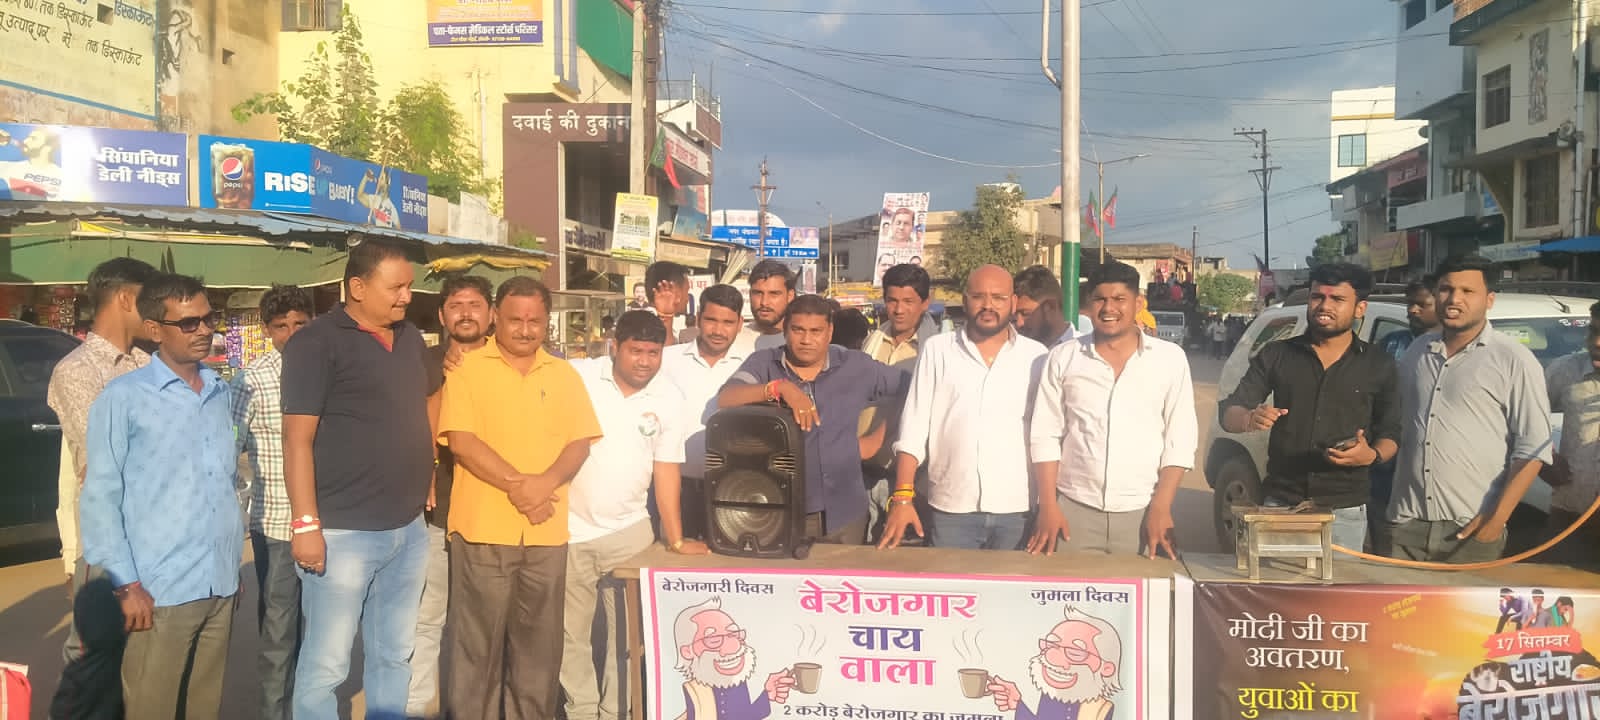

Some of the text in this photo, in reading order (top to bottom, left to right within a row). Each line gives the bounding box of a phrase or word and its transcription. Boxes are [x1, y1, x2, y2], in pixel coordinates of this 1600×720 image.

[512, 109, 631, 136] दवाई की दुकान
[98, 147, 179, 168] सिंघानिया
[98, 164, 132, 182] डेली
[662, 577, 774, 595] बेरोजगारी दिवस
[798, 579, 977, 618] बेरोजगार
[1031, 586, 1129, 605] जुमला दिवस
[848, 625, 924, 651] चाय
[1227, 612, 1370, 643] मोदी जी का
[1496, 638, 1514, 651] 17
[839, 656, 937, 686] वाला
[1245, 647, 1350, 674] अवतरण,
[1508, 649, 1573, 686] राष्ट्रीय
[783, 704, 791, 716] 2
[796, 703, 838, 720] करोड़
[843, 703, 920, 720] बेरोजगार
[949, 712, 1004, 720] जमला
[1237, 681, 1361, 719] युवाओं का
